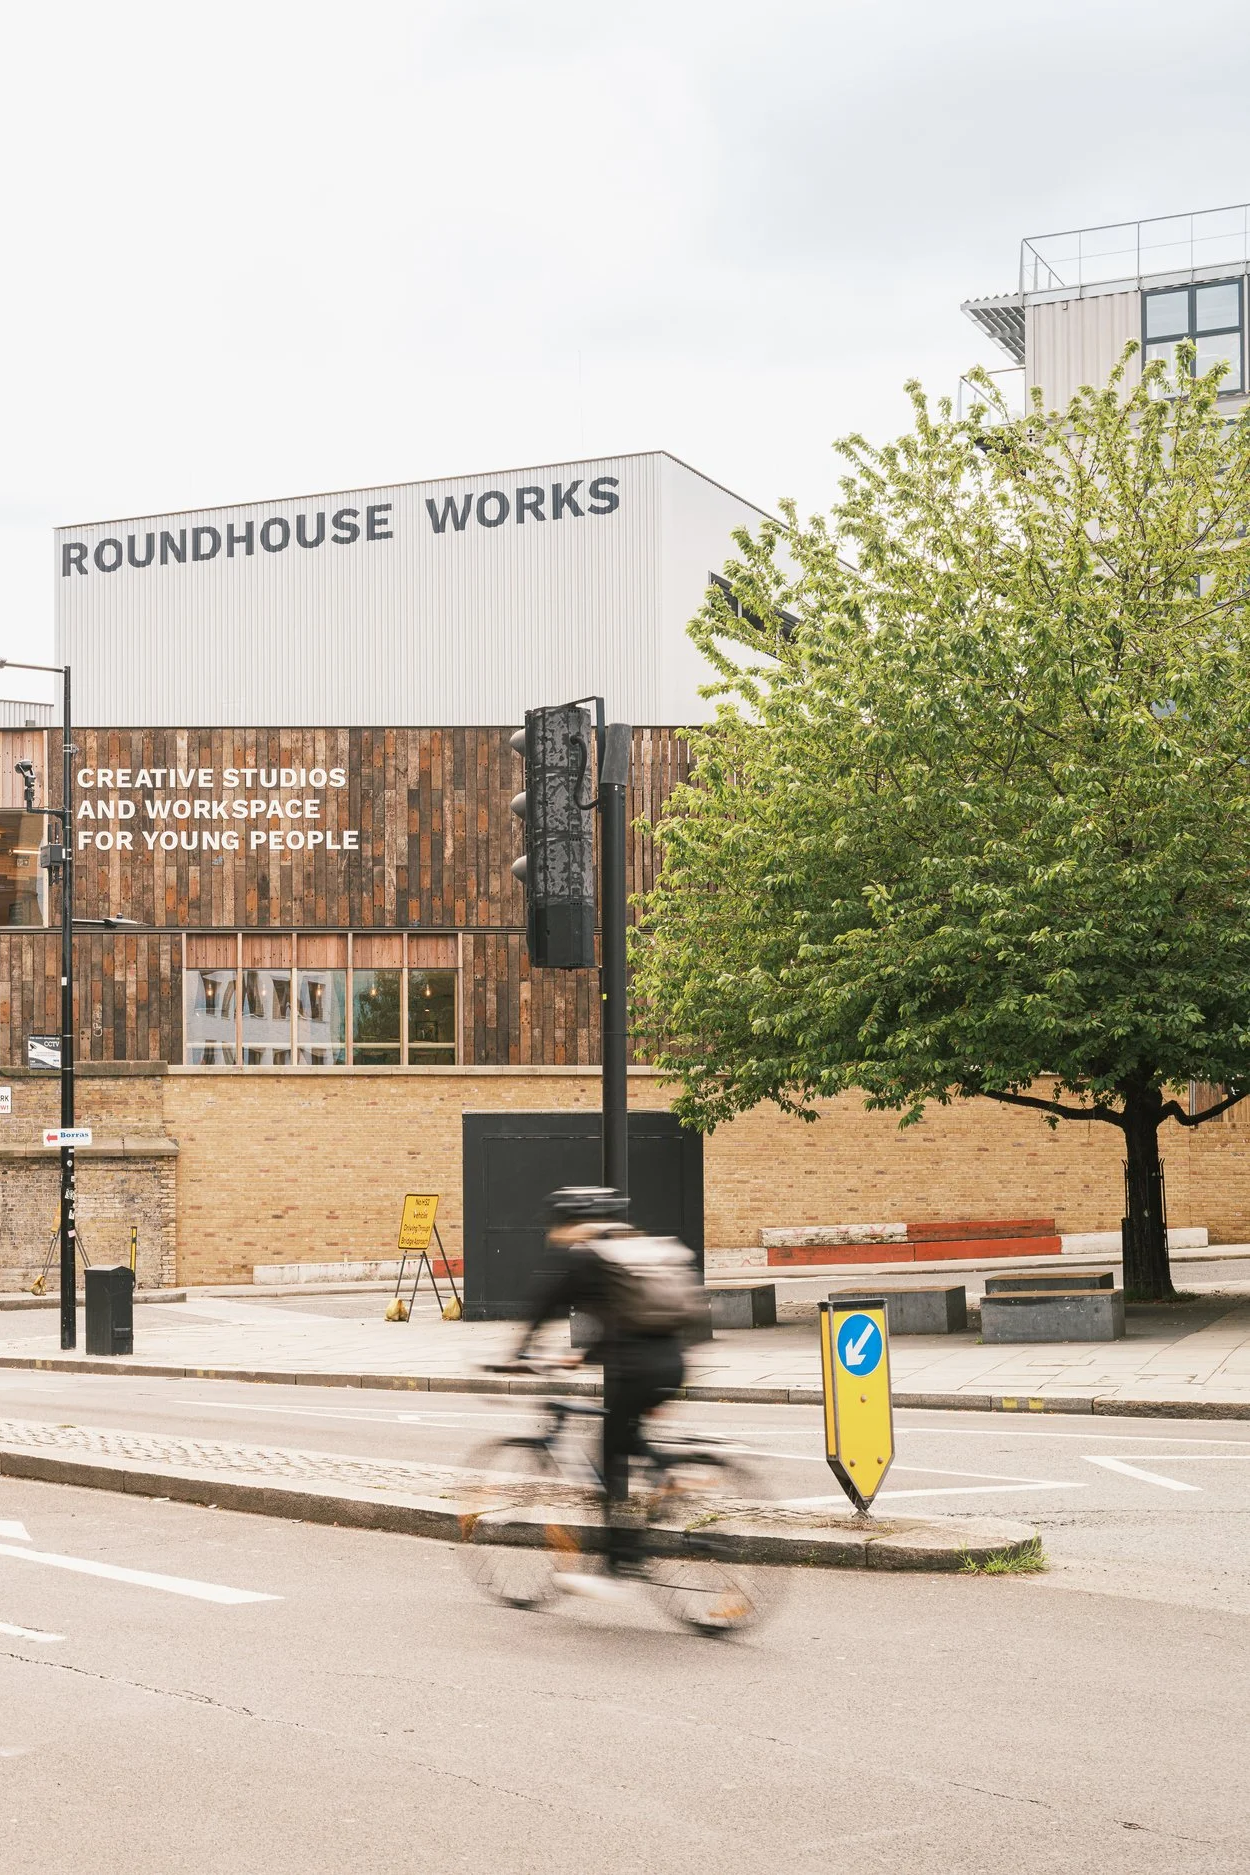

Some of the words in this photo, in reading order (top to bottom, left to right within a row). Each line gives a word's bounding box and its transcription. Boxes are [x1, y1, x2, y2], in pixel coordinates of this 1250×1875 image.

[62, 503, 393, 577] ROUNDHOUSE
[425, 476, 620, 534] WORKS
[77, 768, 214, 788] CREATIVE
[223, 768, 347, 788] STUDIOS
[77, 800, 136, 819] AND
[146, 799, 321, 820] WORKSPACE
[78, 831, 133, 850] FOR
[142, 831, 240, 851] YOUNG
[250, 831, 359, 850] PEOPLE
[413, 1211, 428, 1219] Vehicles
[403, 1224, 418, 1233] Driving
[401, 1236, 414, 1246] Bridge
